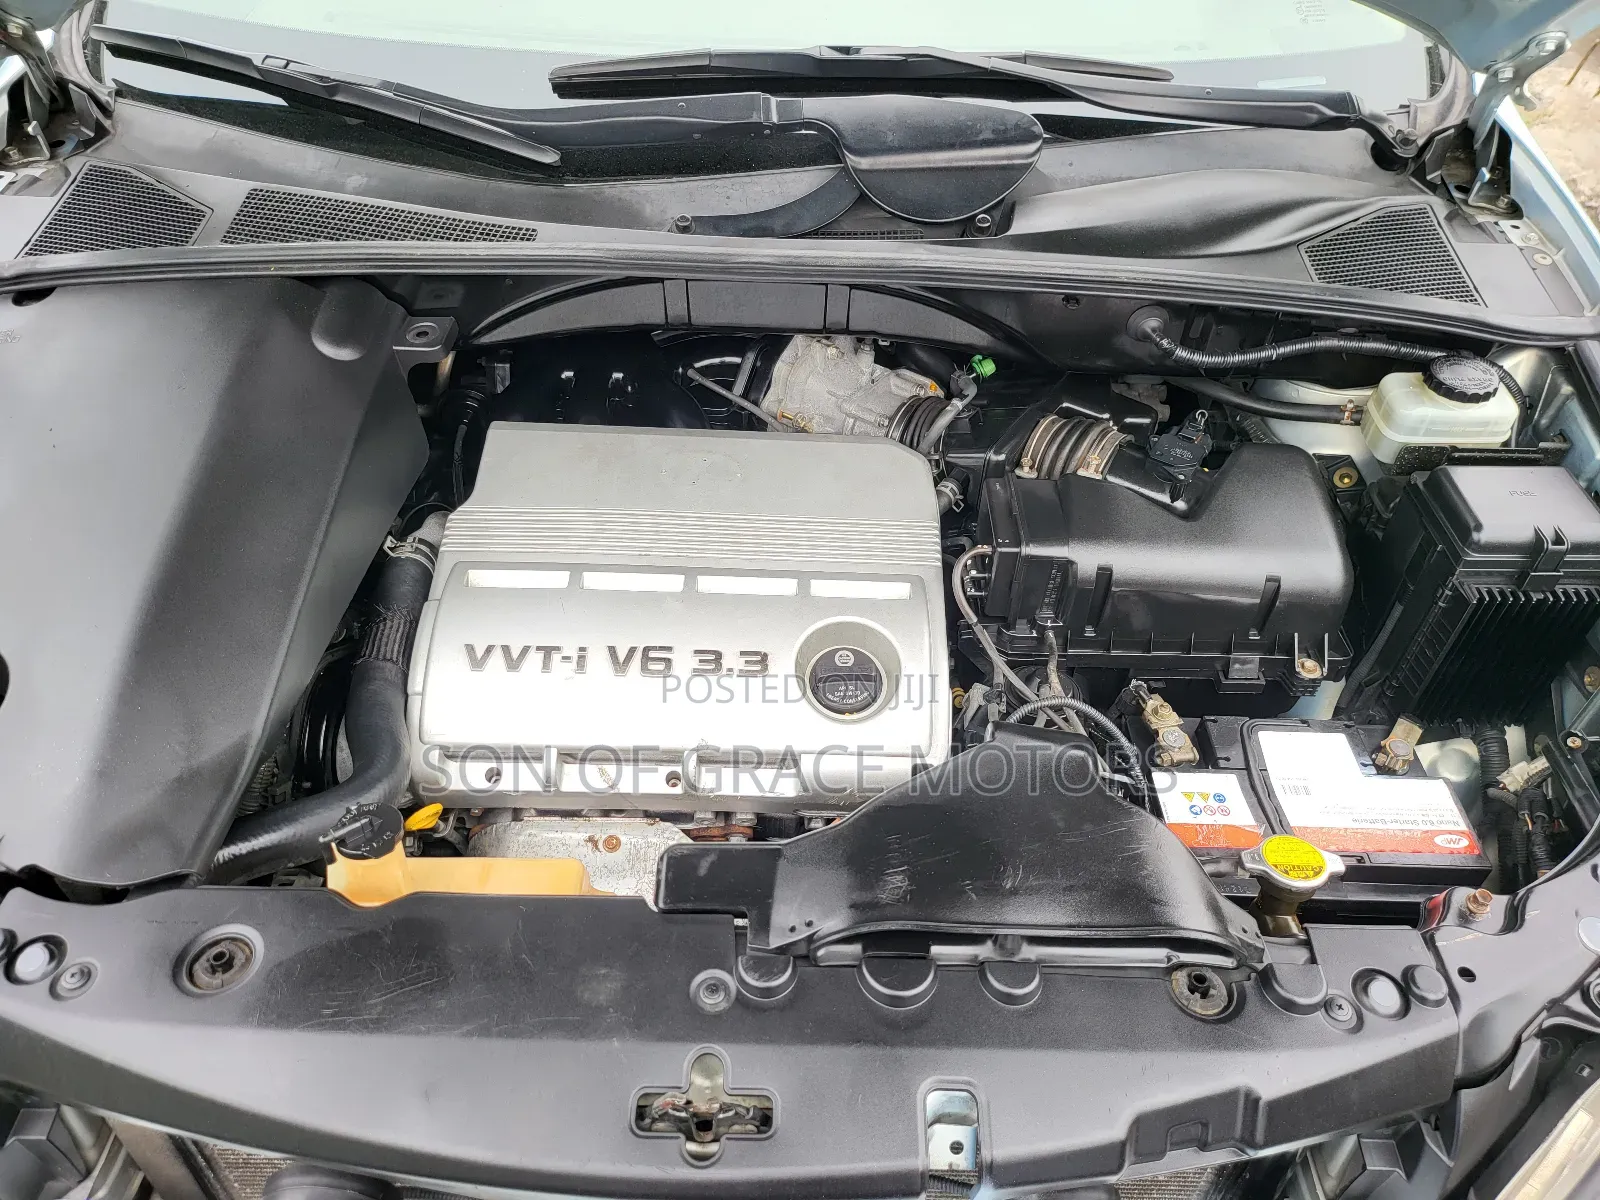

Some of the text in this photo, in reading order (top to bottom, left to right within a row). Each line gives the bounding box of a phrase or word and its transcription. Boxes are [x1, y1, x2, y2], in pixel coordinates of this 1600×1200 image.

[463, 643, 770, 679] VVT-i V6 3.3
[1277, 863, 1321, 872] CAUTION
